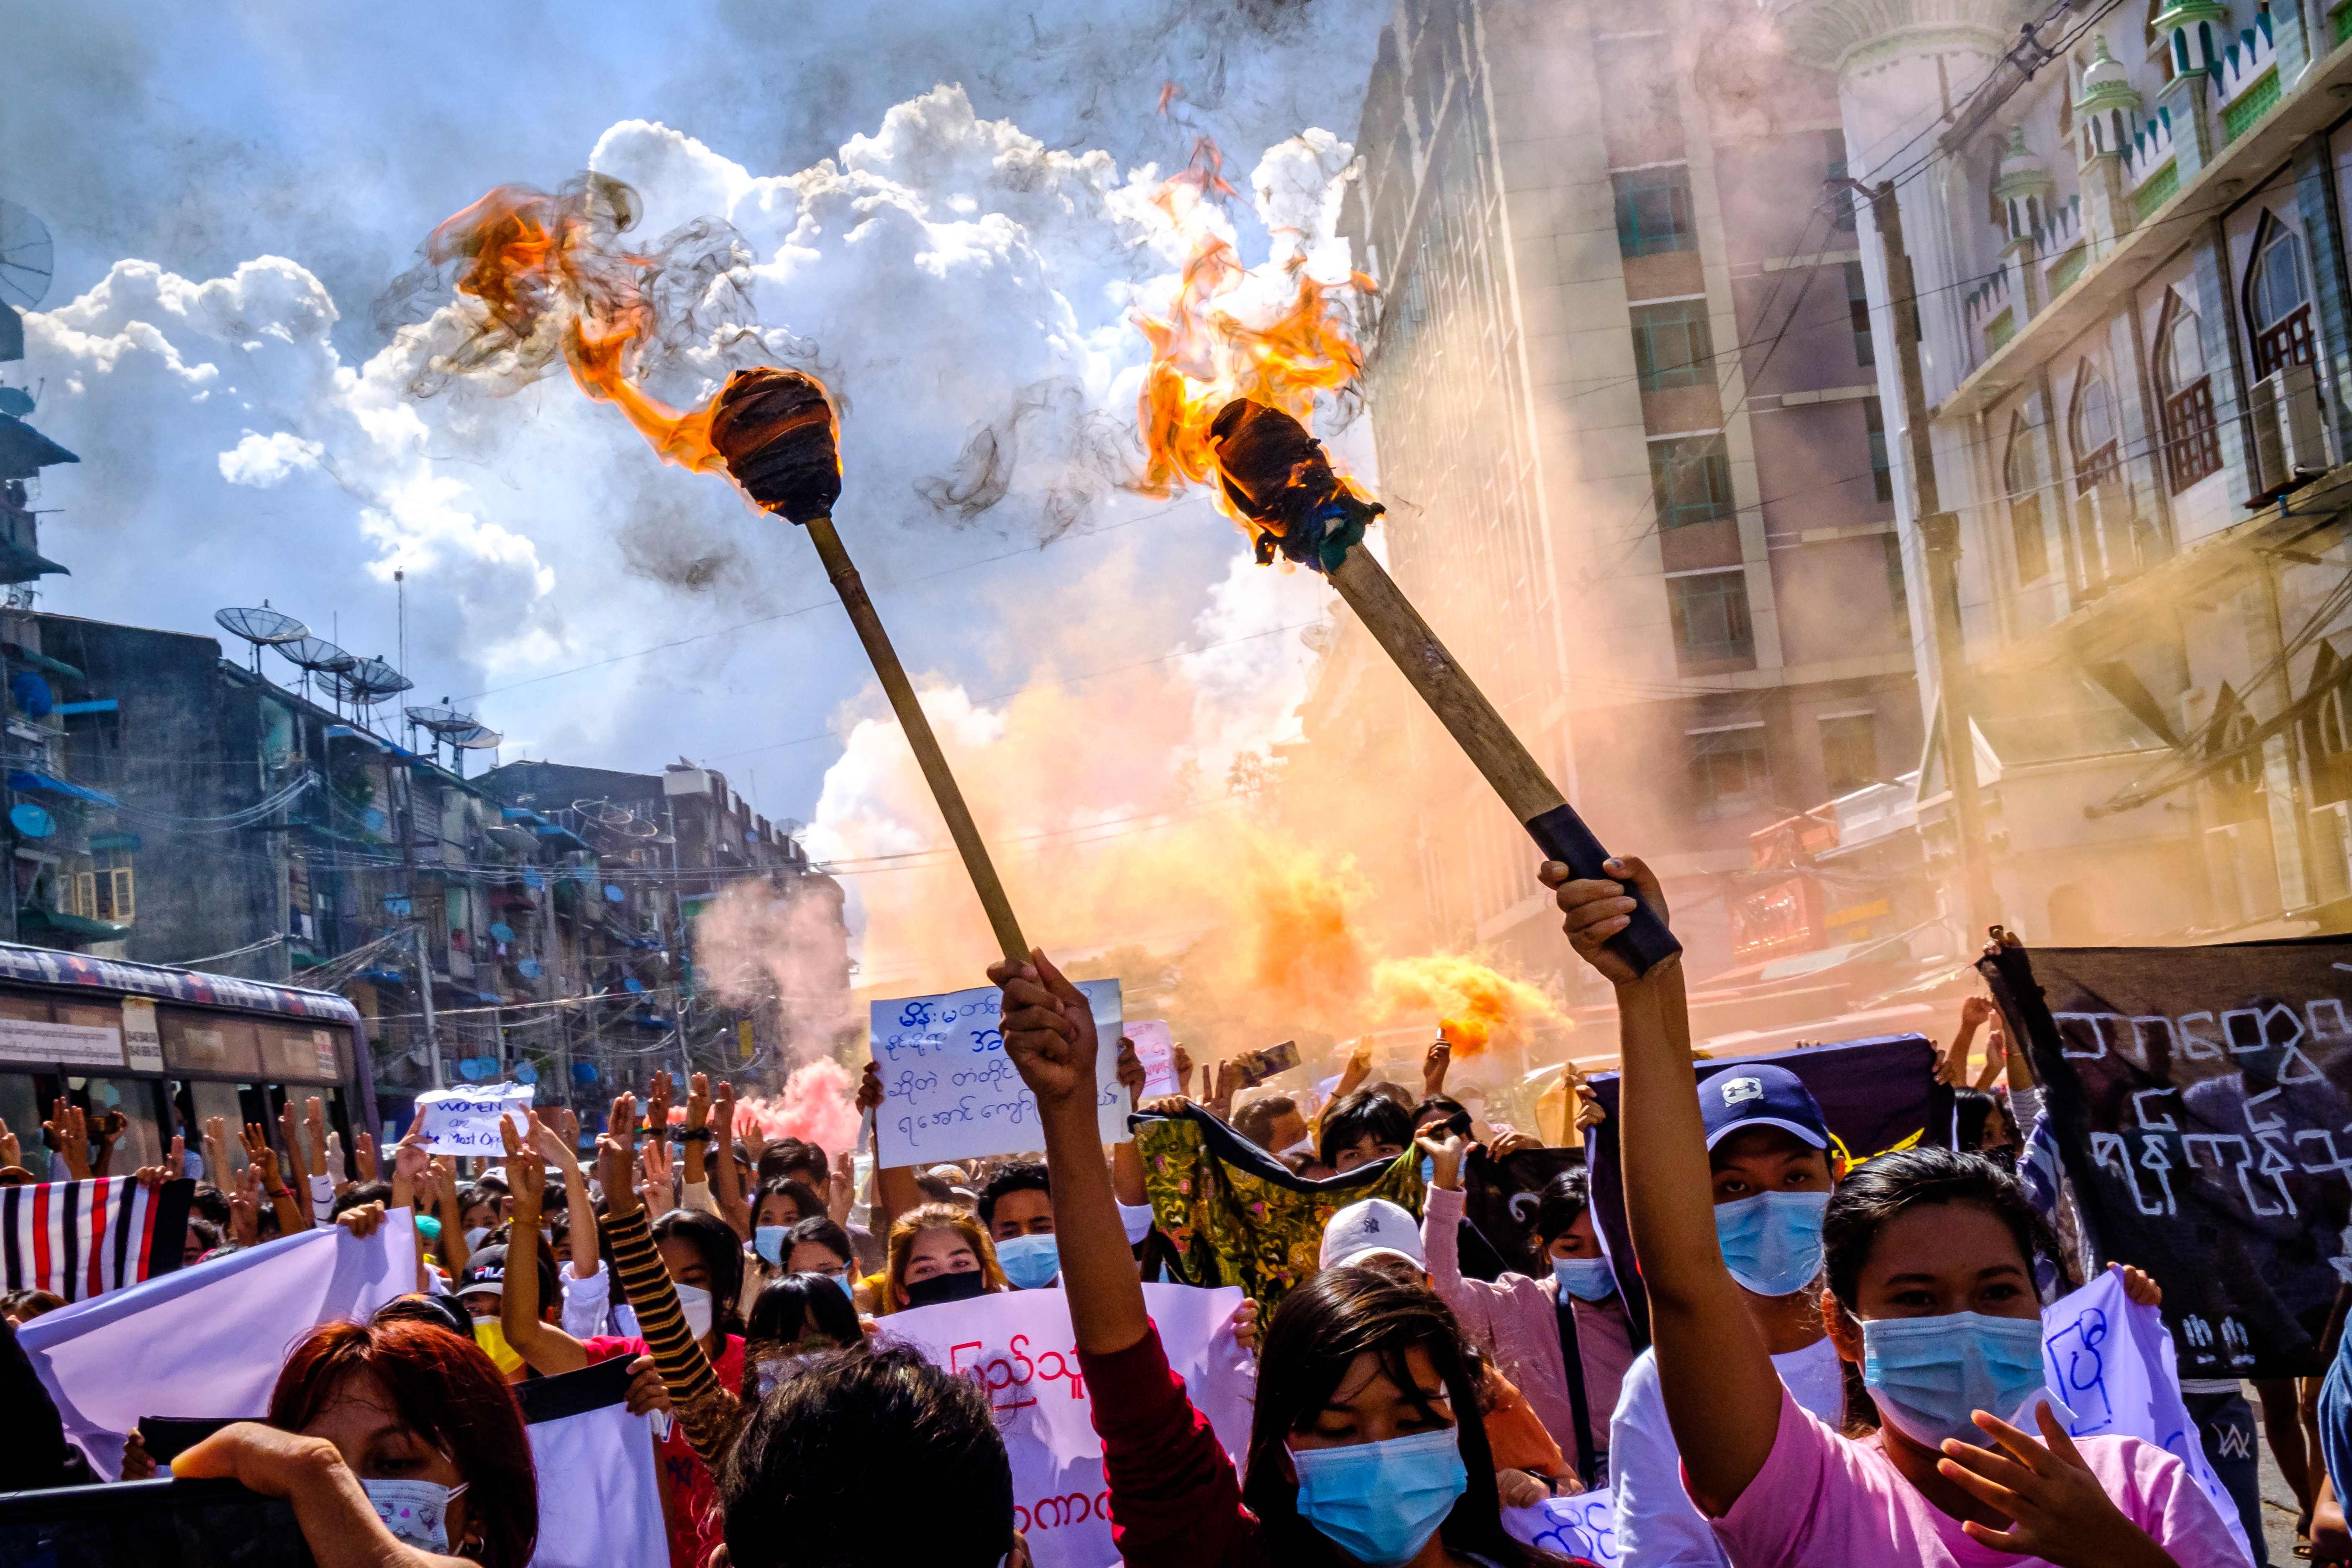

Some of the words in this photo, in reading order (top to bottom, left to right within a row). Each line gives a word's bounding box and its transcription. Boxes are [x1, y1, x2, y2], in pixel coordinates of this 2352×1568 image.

[436, 1101, 502, 1112] WOMEN
[448, 1131, 475, 1145] Most
[480, 1132, 502, 1149] Opp
